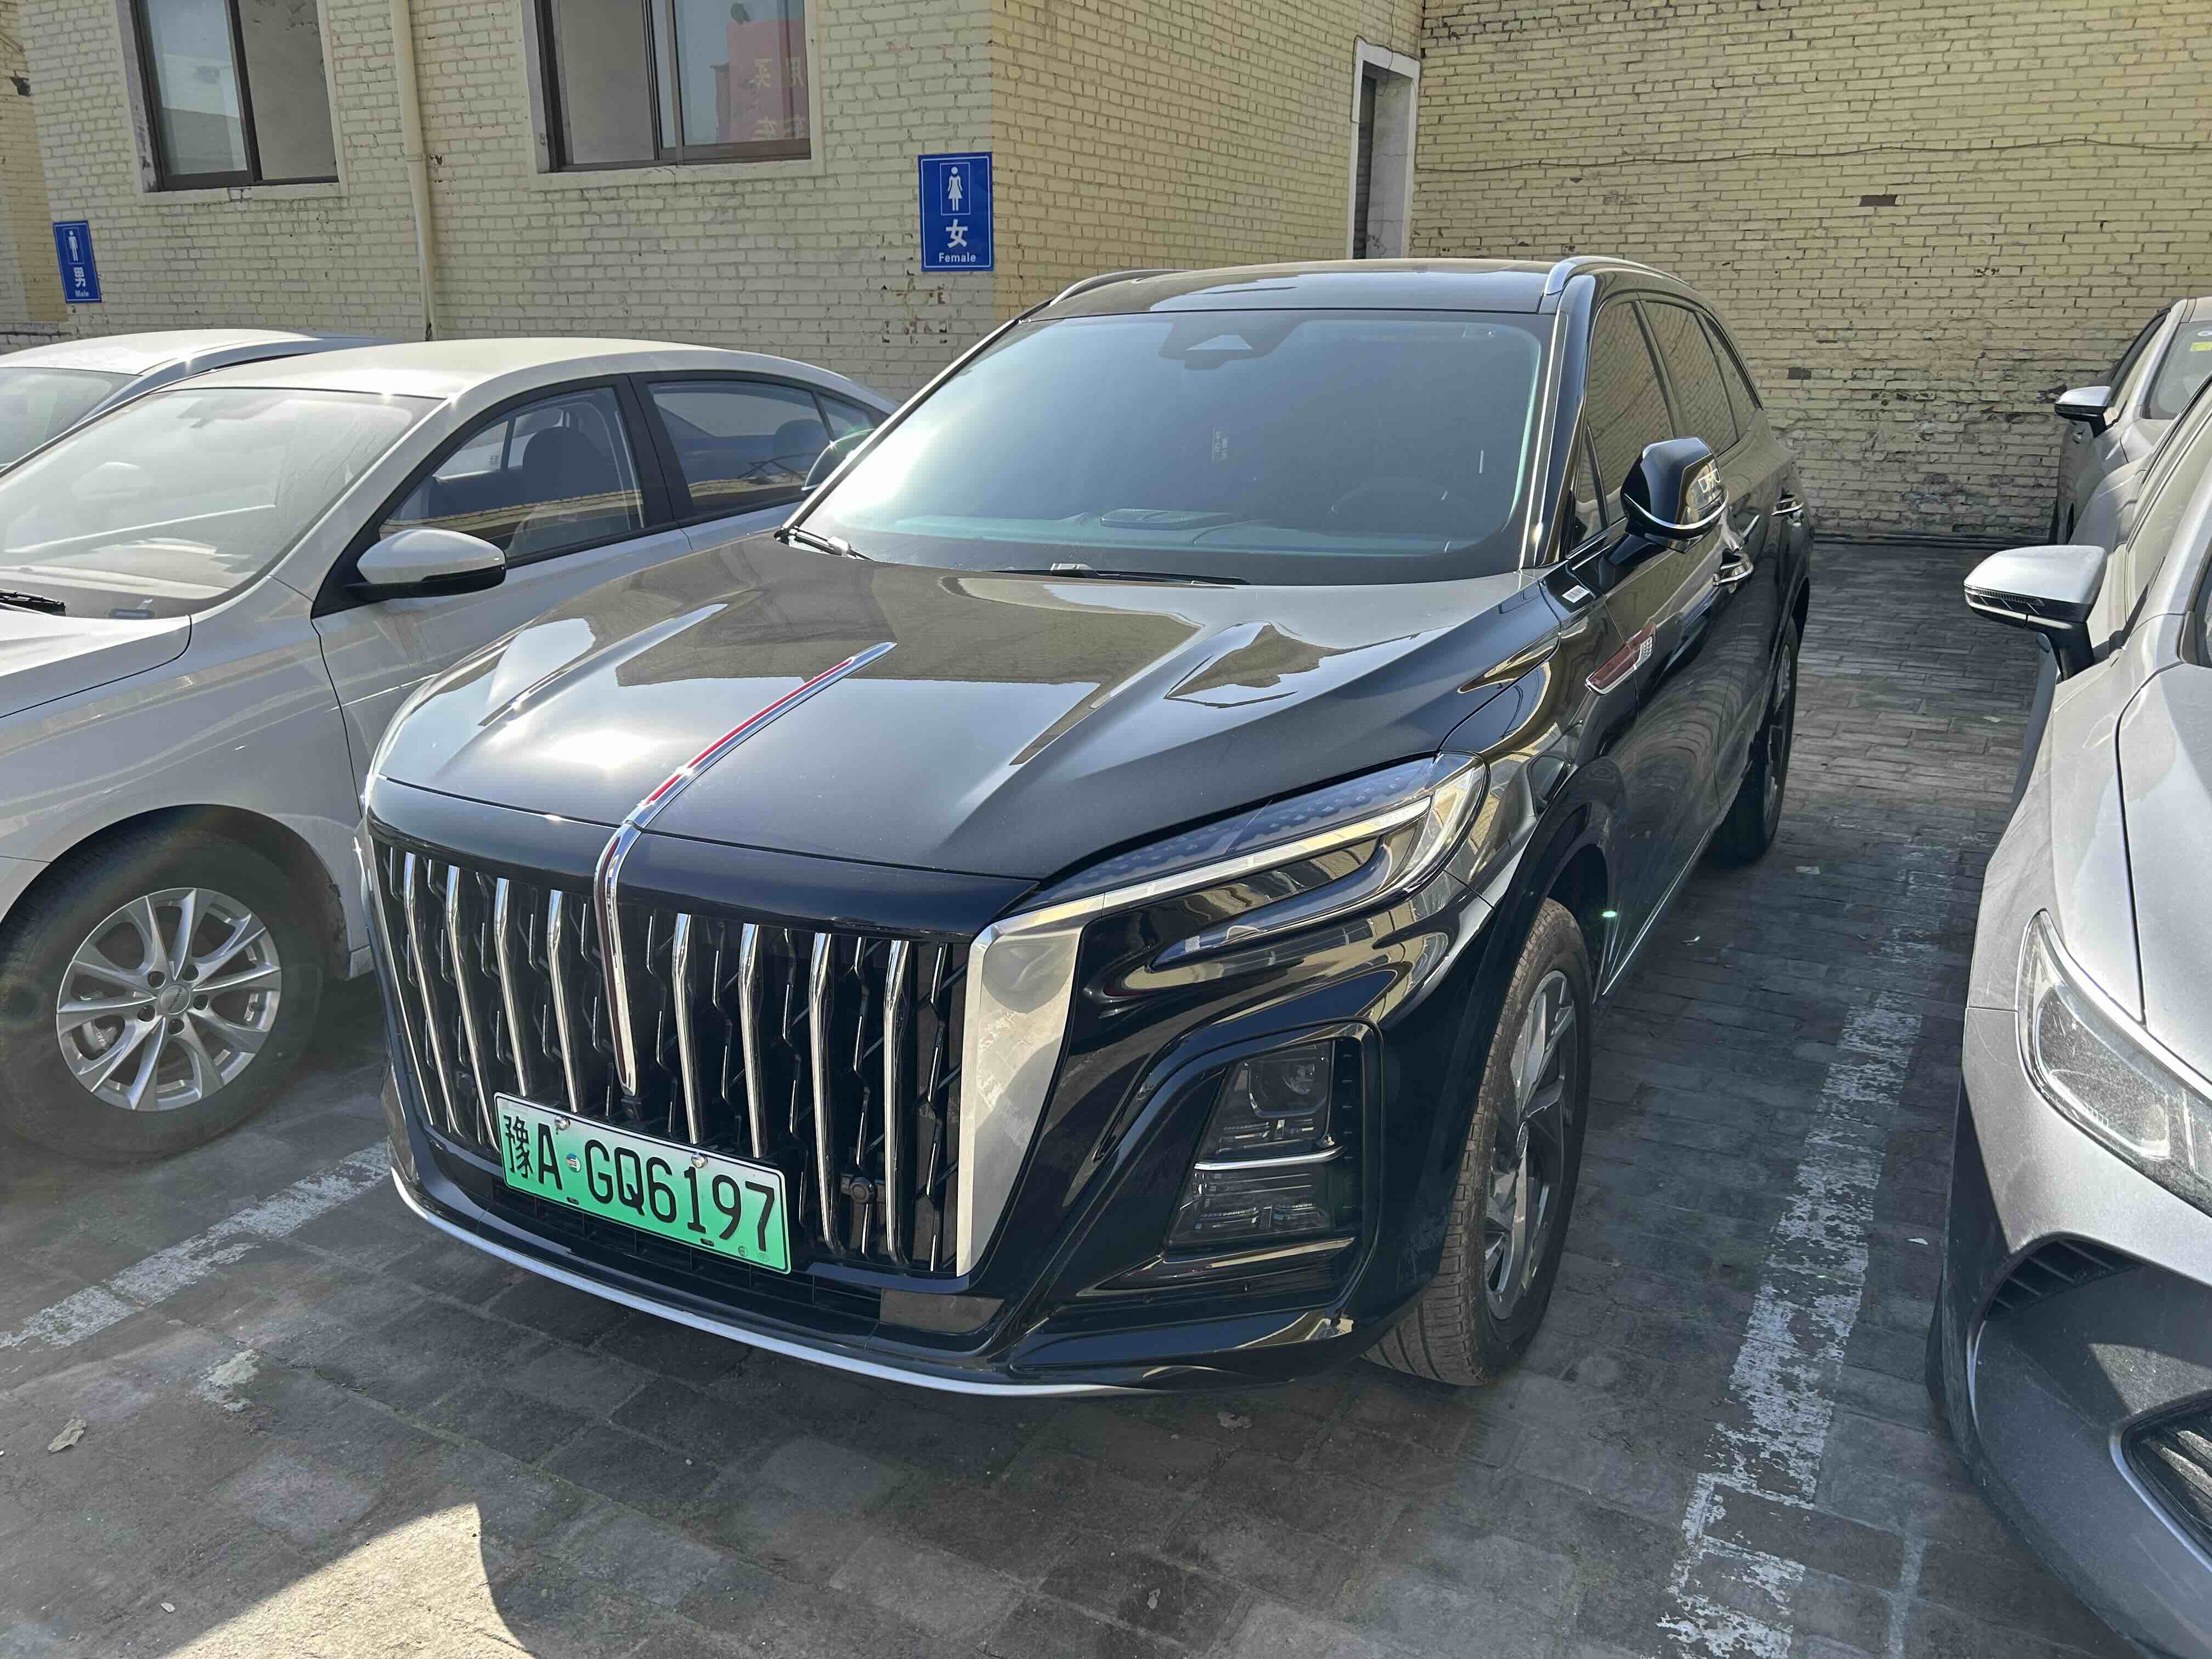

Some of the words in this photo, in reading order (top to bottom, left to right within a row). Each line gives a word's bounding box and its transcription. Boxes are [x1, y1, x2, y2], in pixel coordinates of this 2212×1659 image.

[945, 219, 968, 248] 女
[939, 252, 976, 262] Female
[74, 267, 86, 287] 男
